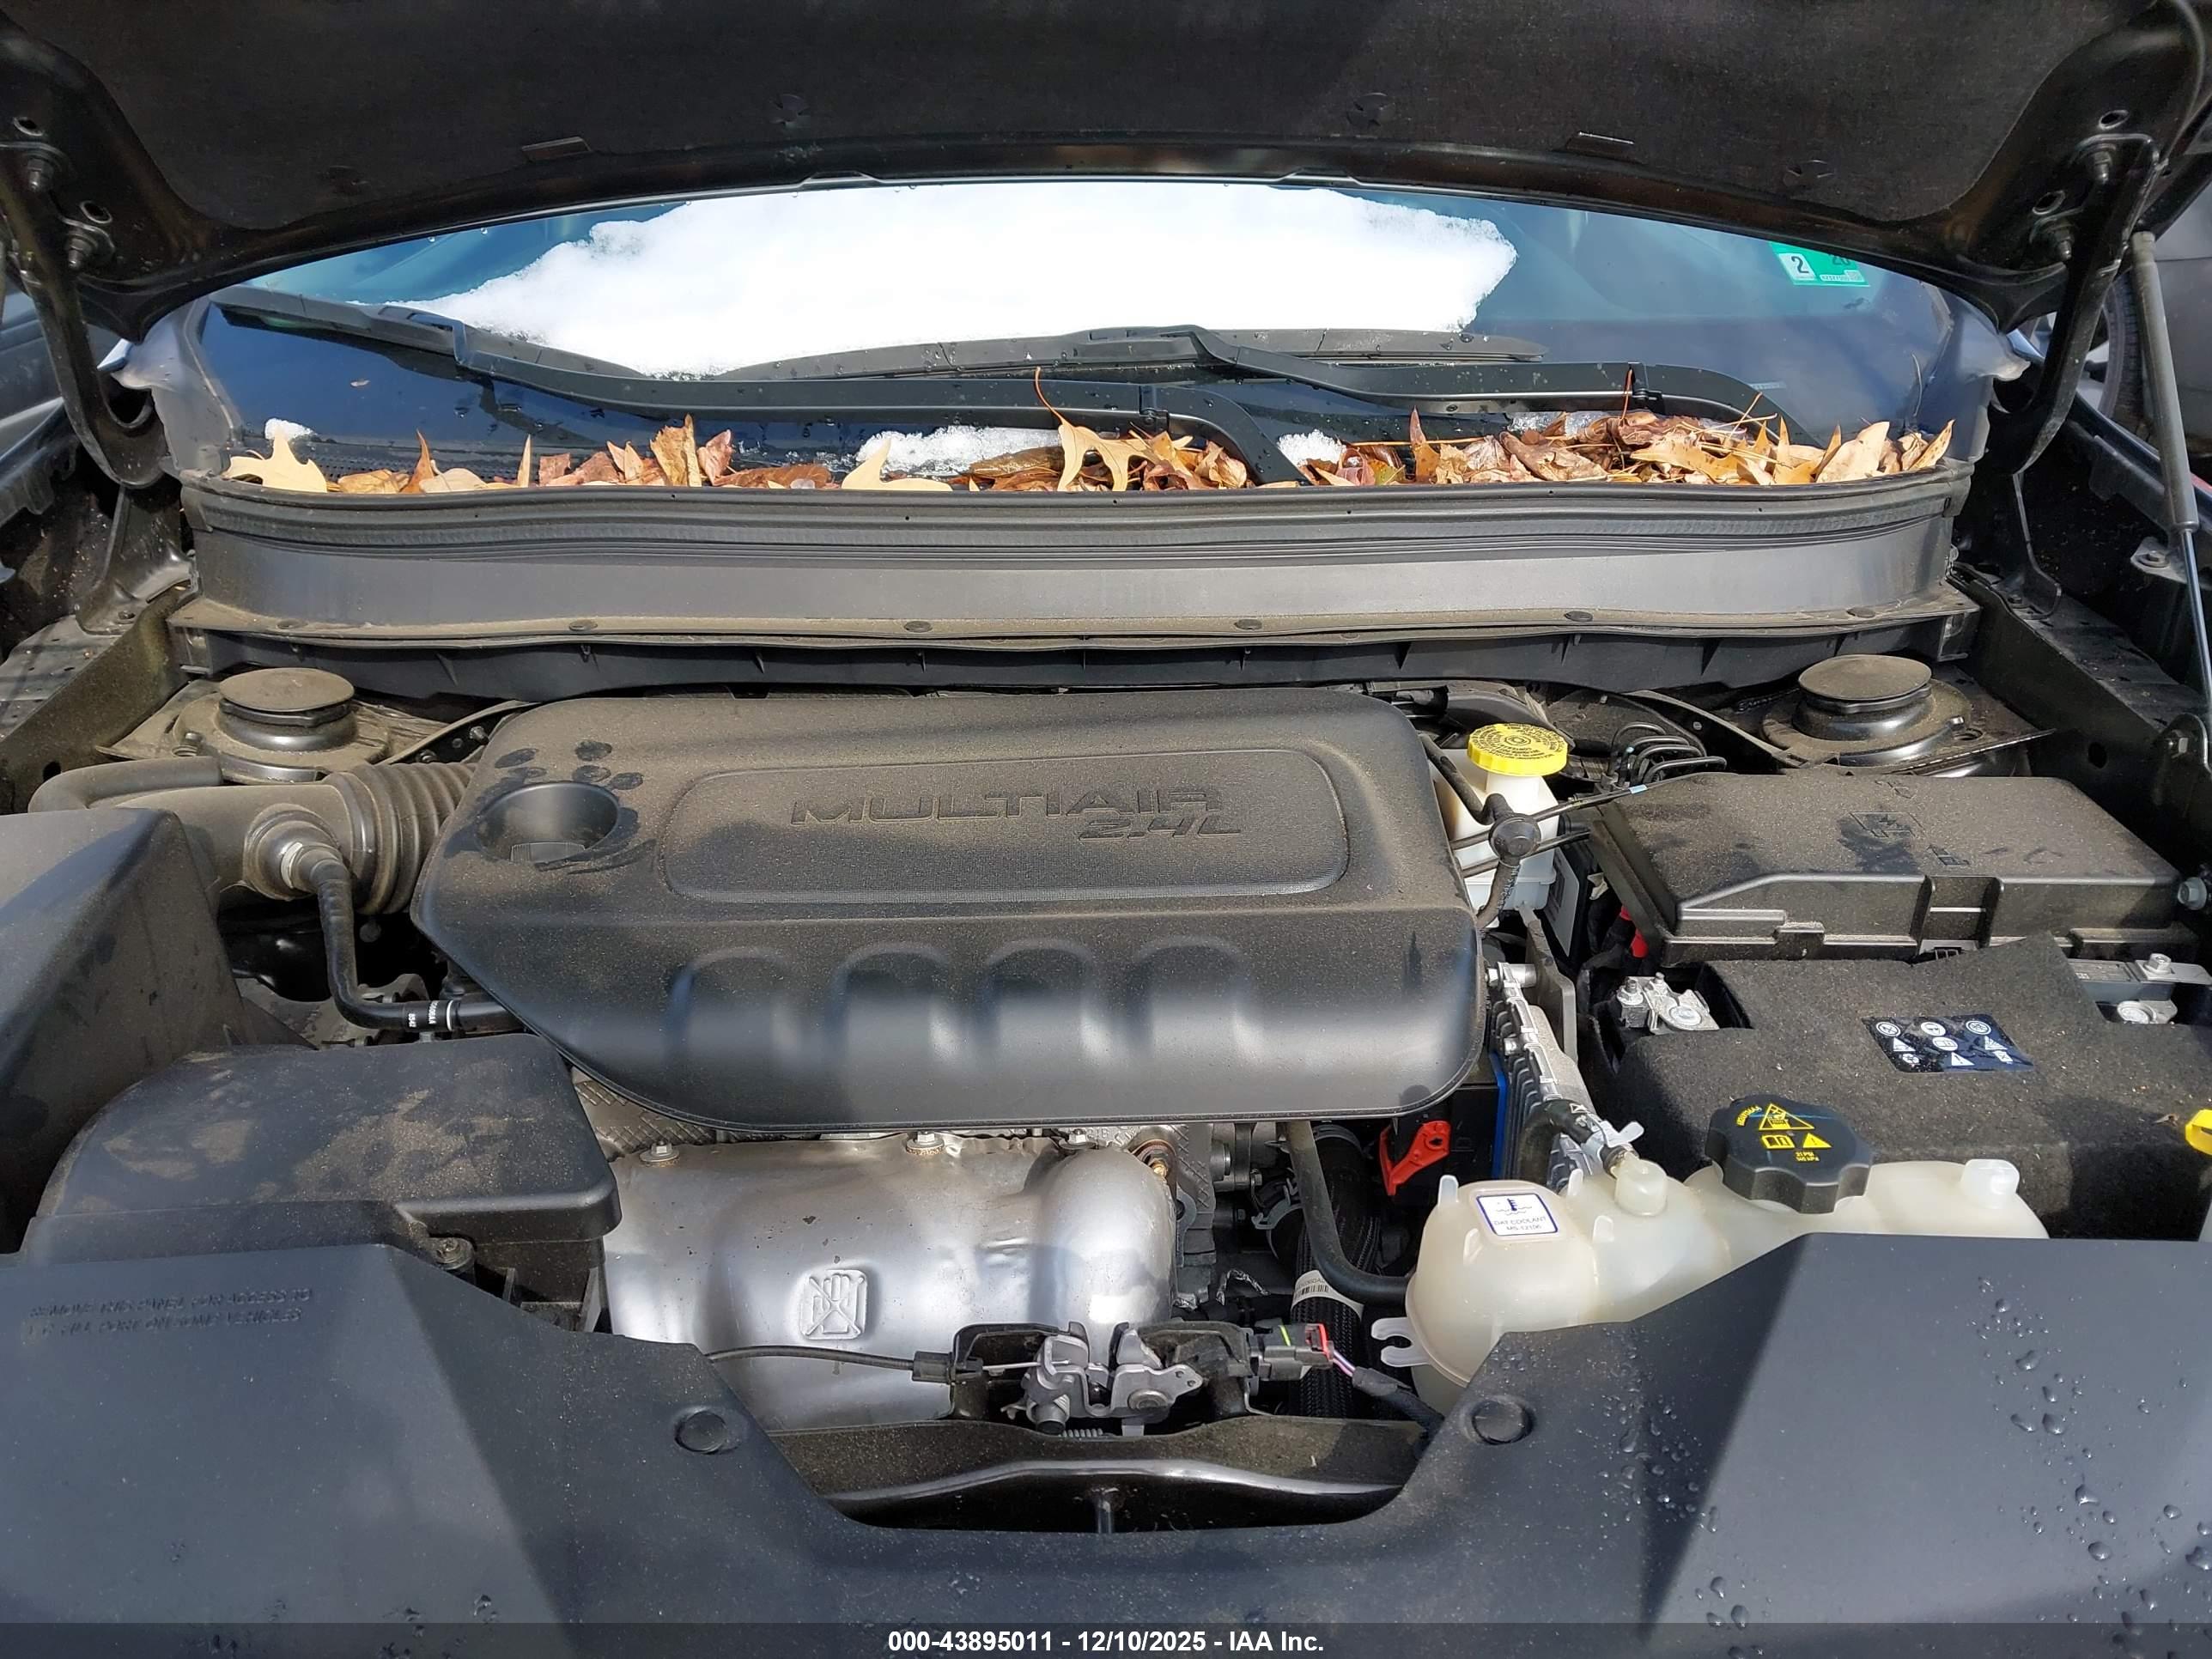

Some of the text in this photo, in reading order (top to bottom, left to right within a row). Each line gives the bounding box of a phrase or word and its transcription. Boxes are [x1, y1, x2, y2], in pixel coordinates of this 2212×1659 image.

[1790, 256, 1809, 274] 2
[790, 787, 1222, 825] MULTIAIR
[1078, 817, 1241, 842] 2.4L
[1510, 1216, 1547, 1224] COOLANT
[228, 1290, 287, 1304] ACCESS
[292, 1288, 313, 1301] TO
[227, 1307, 301, 1324] VEHICLES
